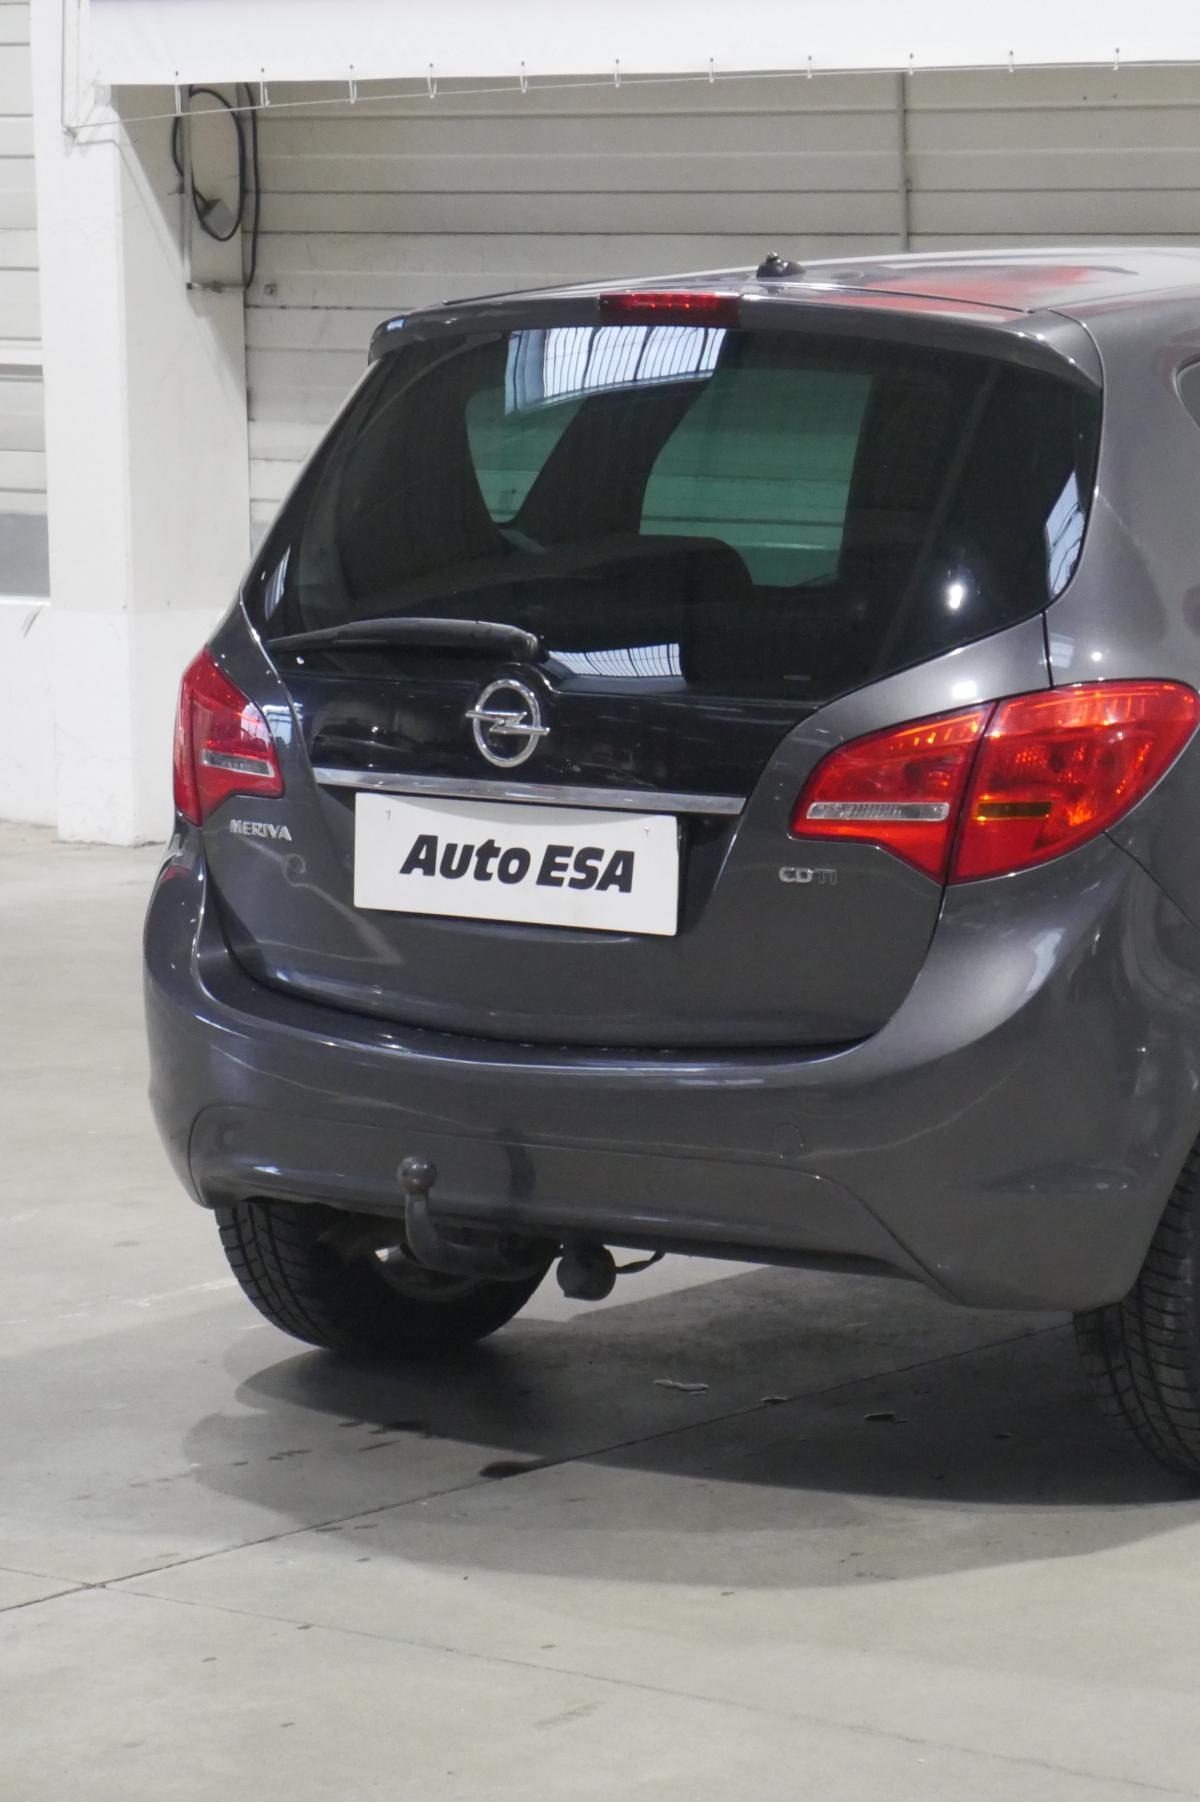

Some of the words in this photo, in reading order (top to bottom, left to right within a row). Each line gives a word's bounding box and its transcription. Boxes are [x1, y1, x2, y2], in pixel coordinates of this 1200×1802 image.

[229, 819, 293, 841] MERIVA
[399, 834, 531, 885] Auto
[536, 844, 635, 893] ESA
